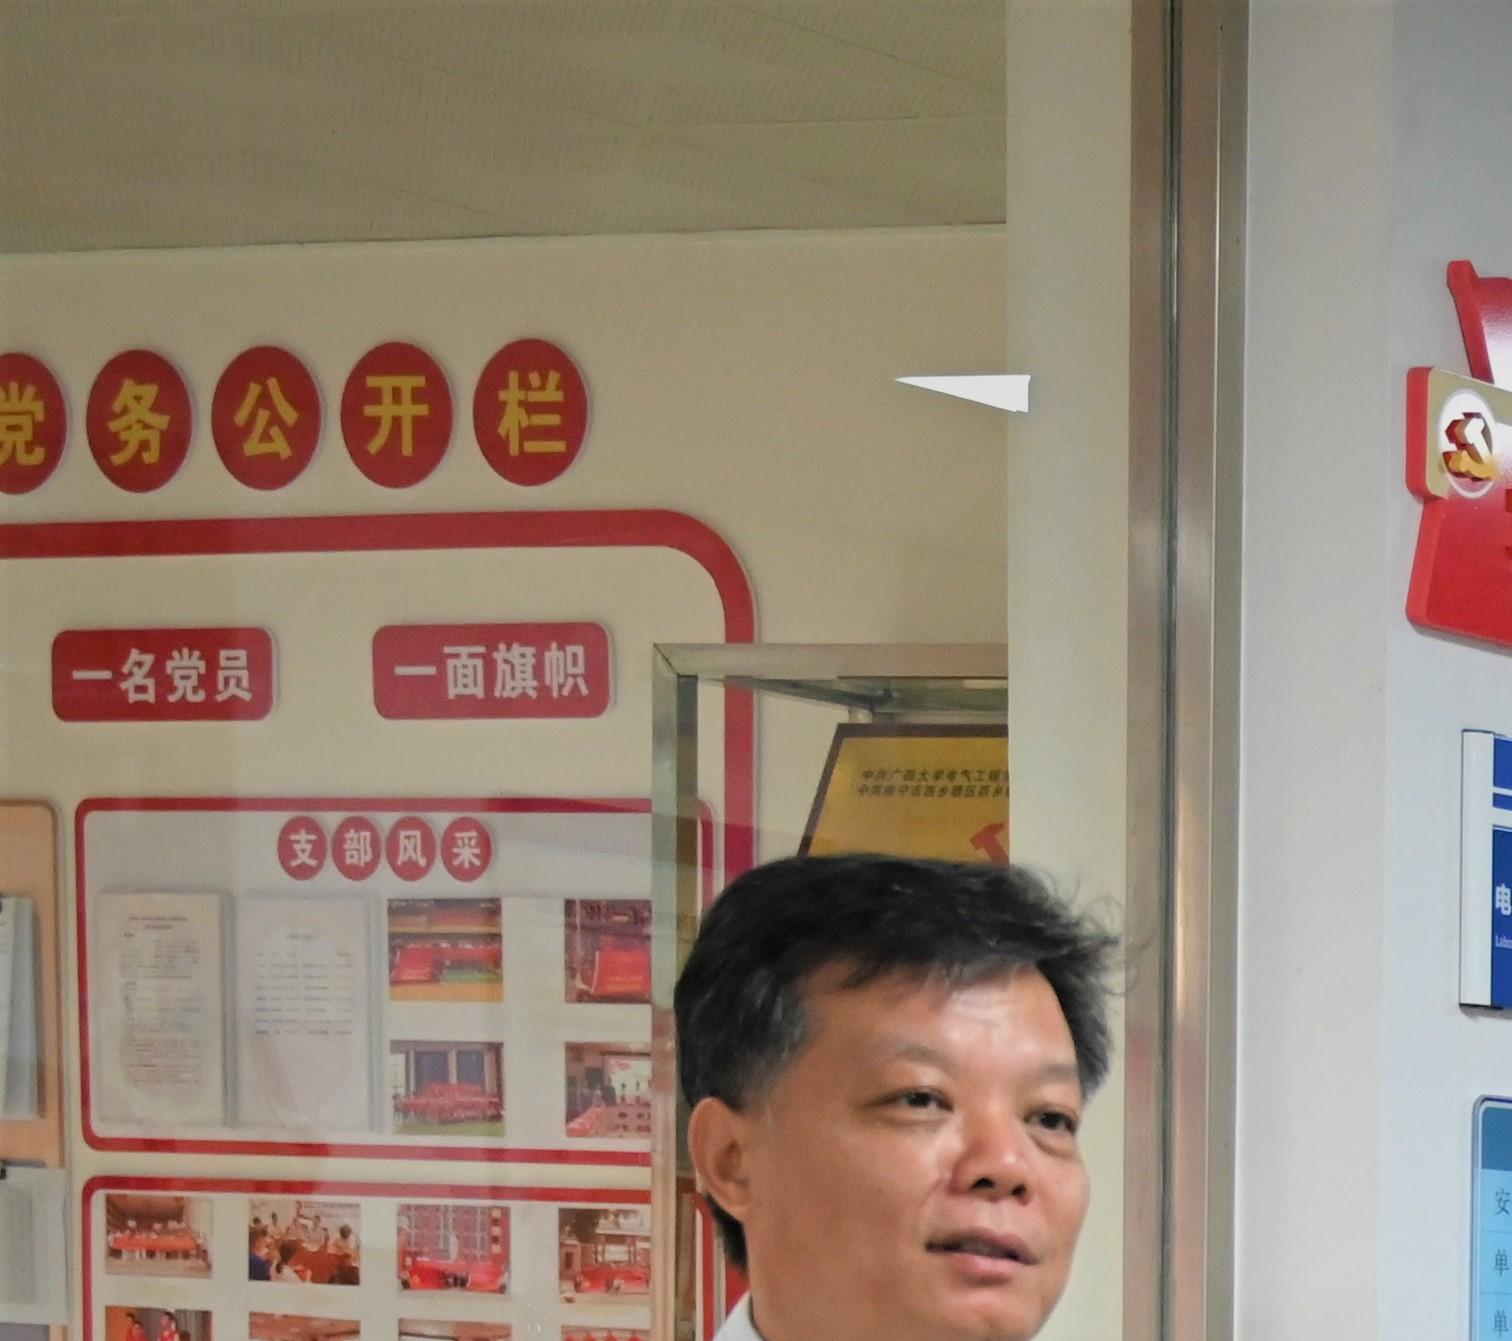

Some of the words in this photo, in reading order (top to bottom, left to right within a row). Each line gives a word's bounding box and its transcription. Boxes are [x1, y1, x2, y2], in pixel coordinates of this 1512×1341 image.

[0, 371, 567, 466] 党务公开栏
[72, 646, 254, 704] 一名党员
[395, 643, 590, 700] 一面旗帜
[289, 829, 482, 869] 支部风采
